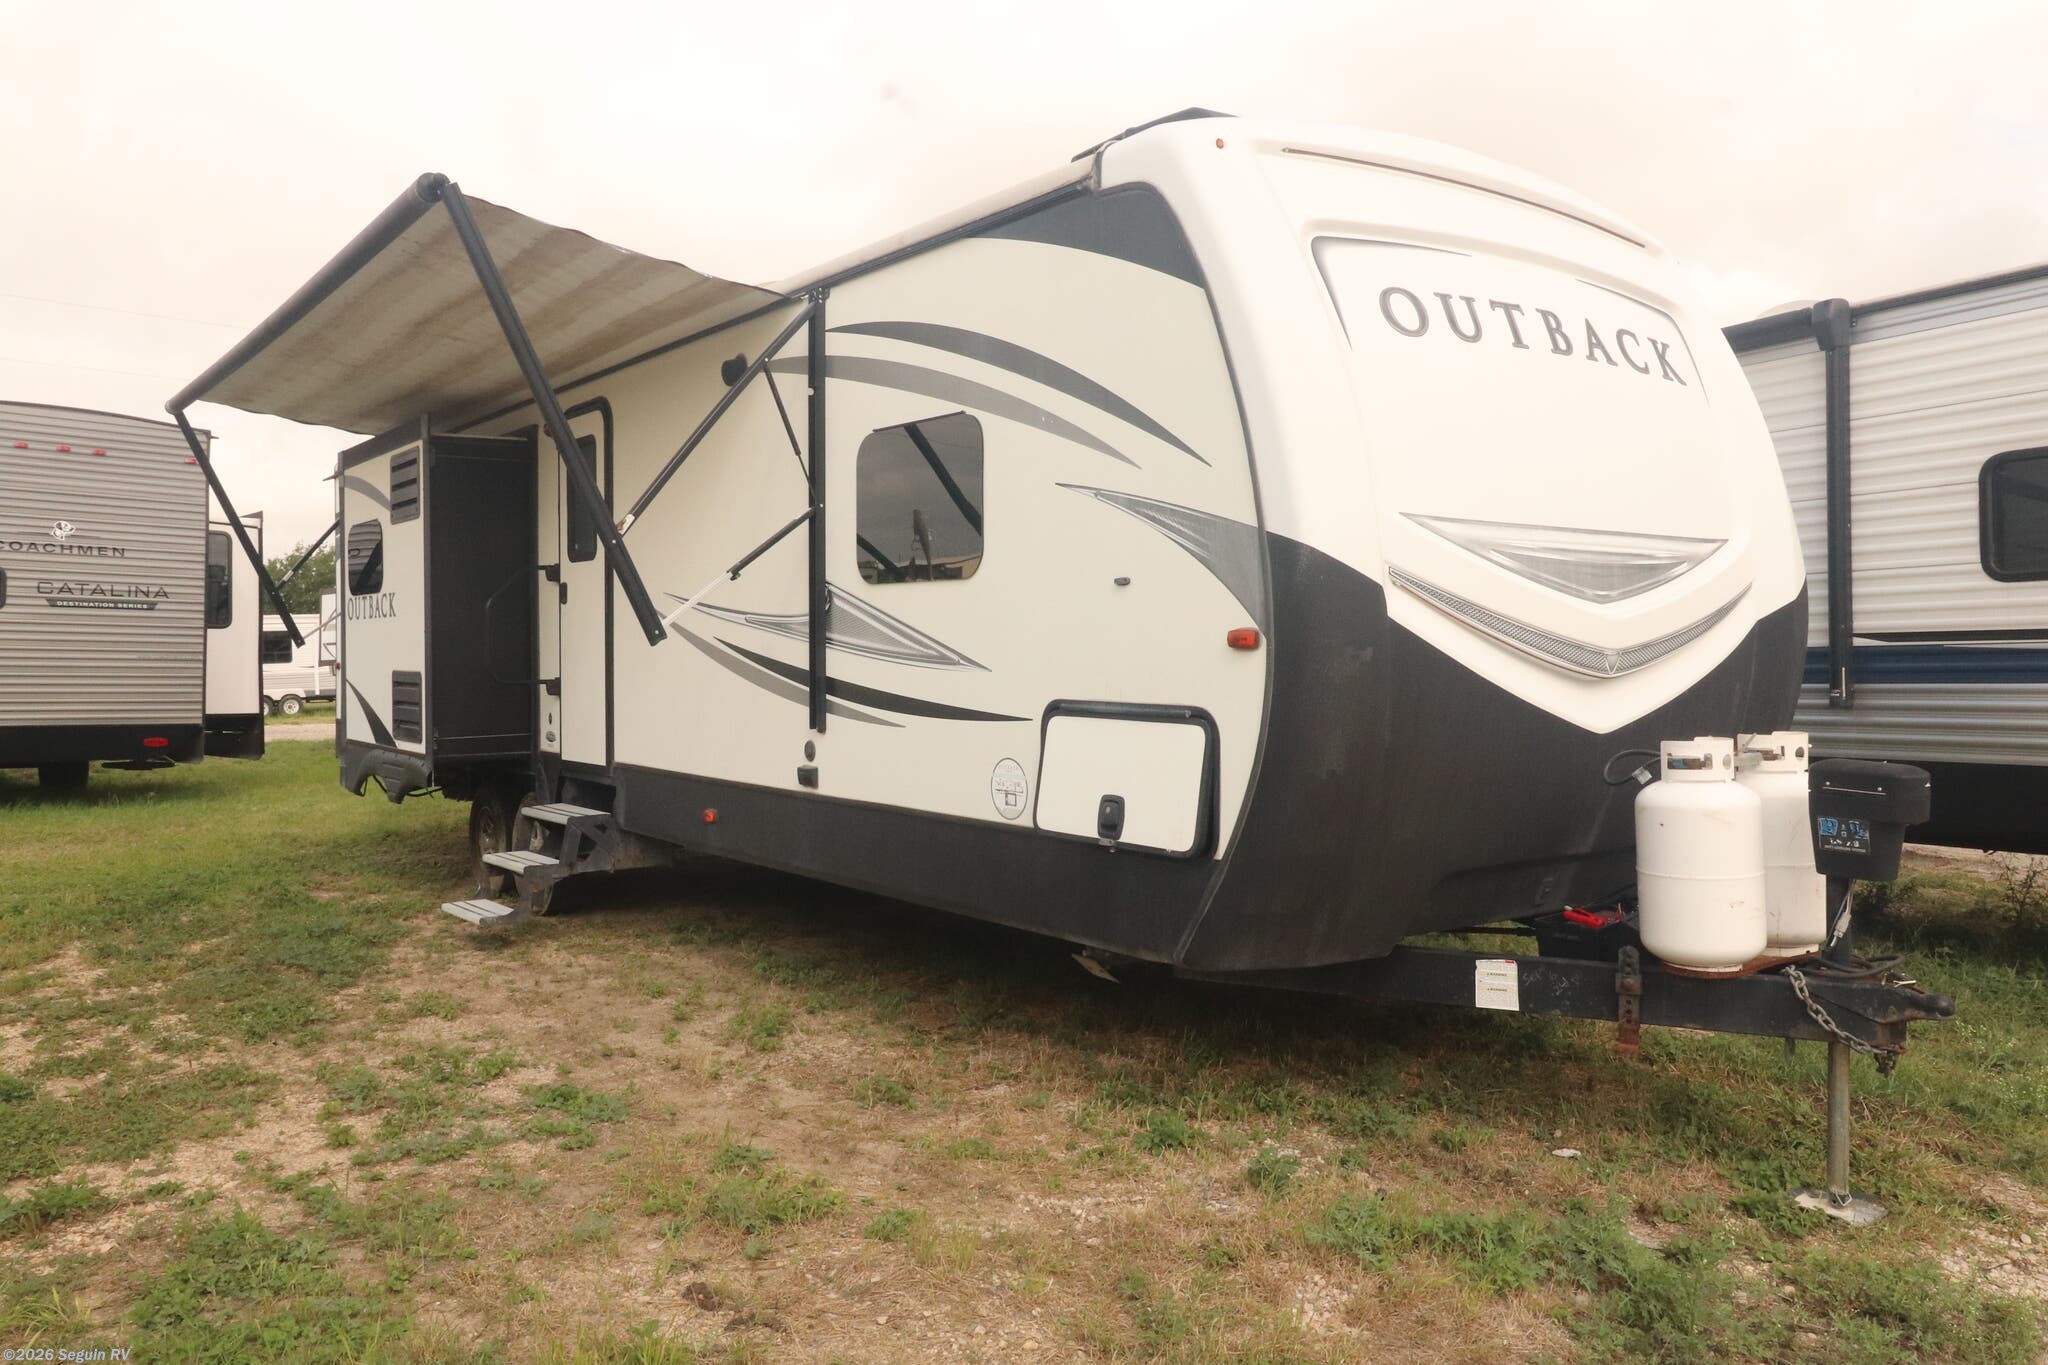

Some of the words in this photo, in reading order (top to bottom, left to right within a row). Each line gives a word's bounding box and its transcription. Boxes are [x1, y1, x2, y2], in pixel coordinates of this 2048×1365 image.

[1379, 286, 1687, 386] OUTBACK
[37, 581, 170, 599] CATALINA
[56, 600, 115, 608] DESTINATION
[347, 592, 396, 620] OUTBACK
